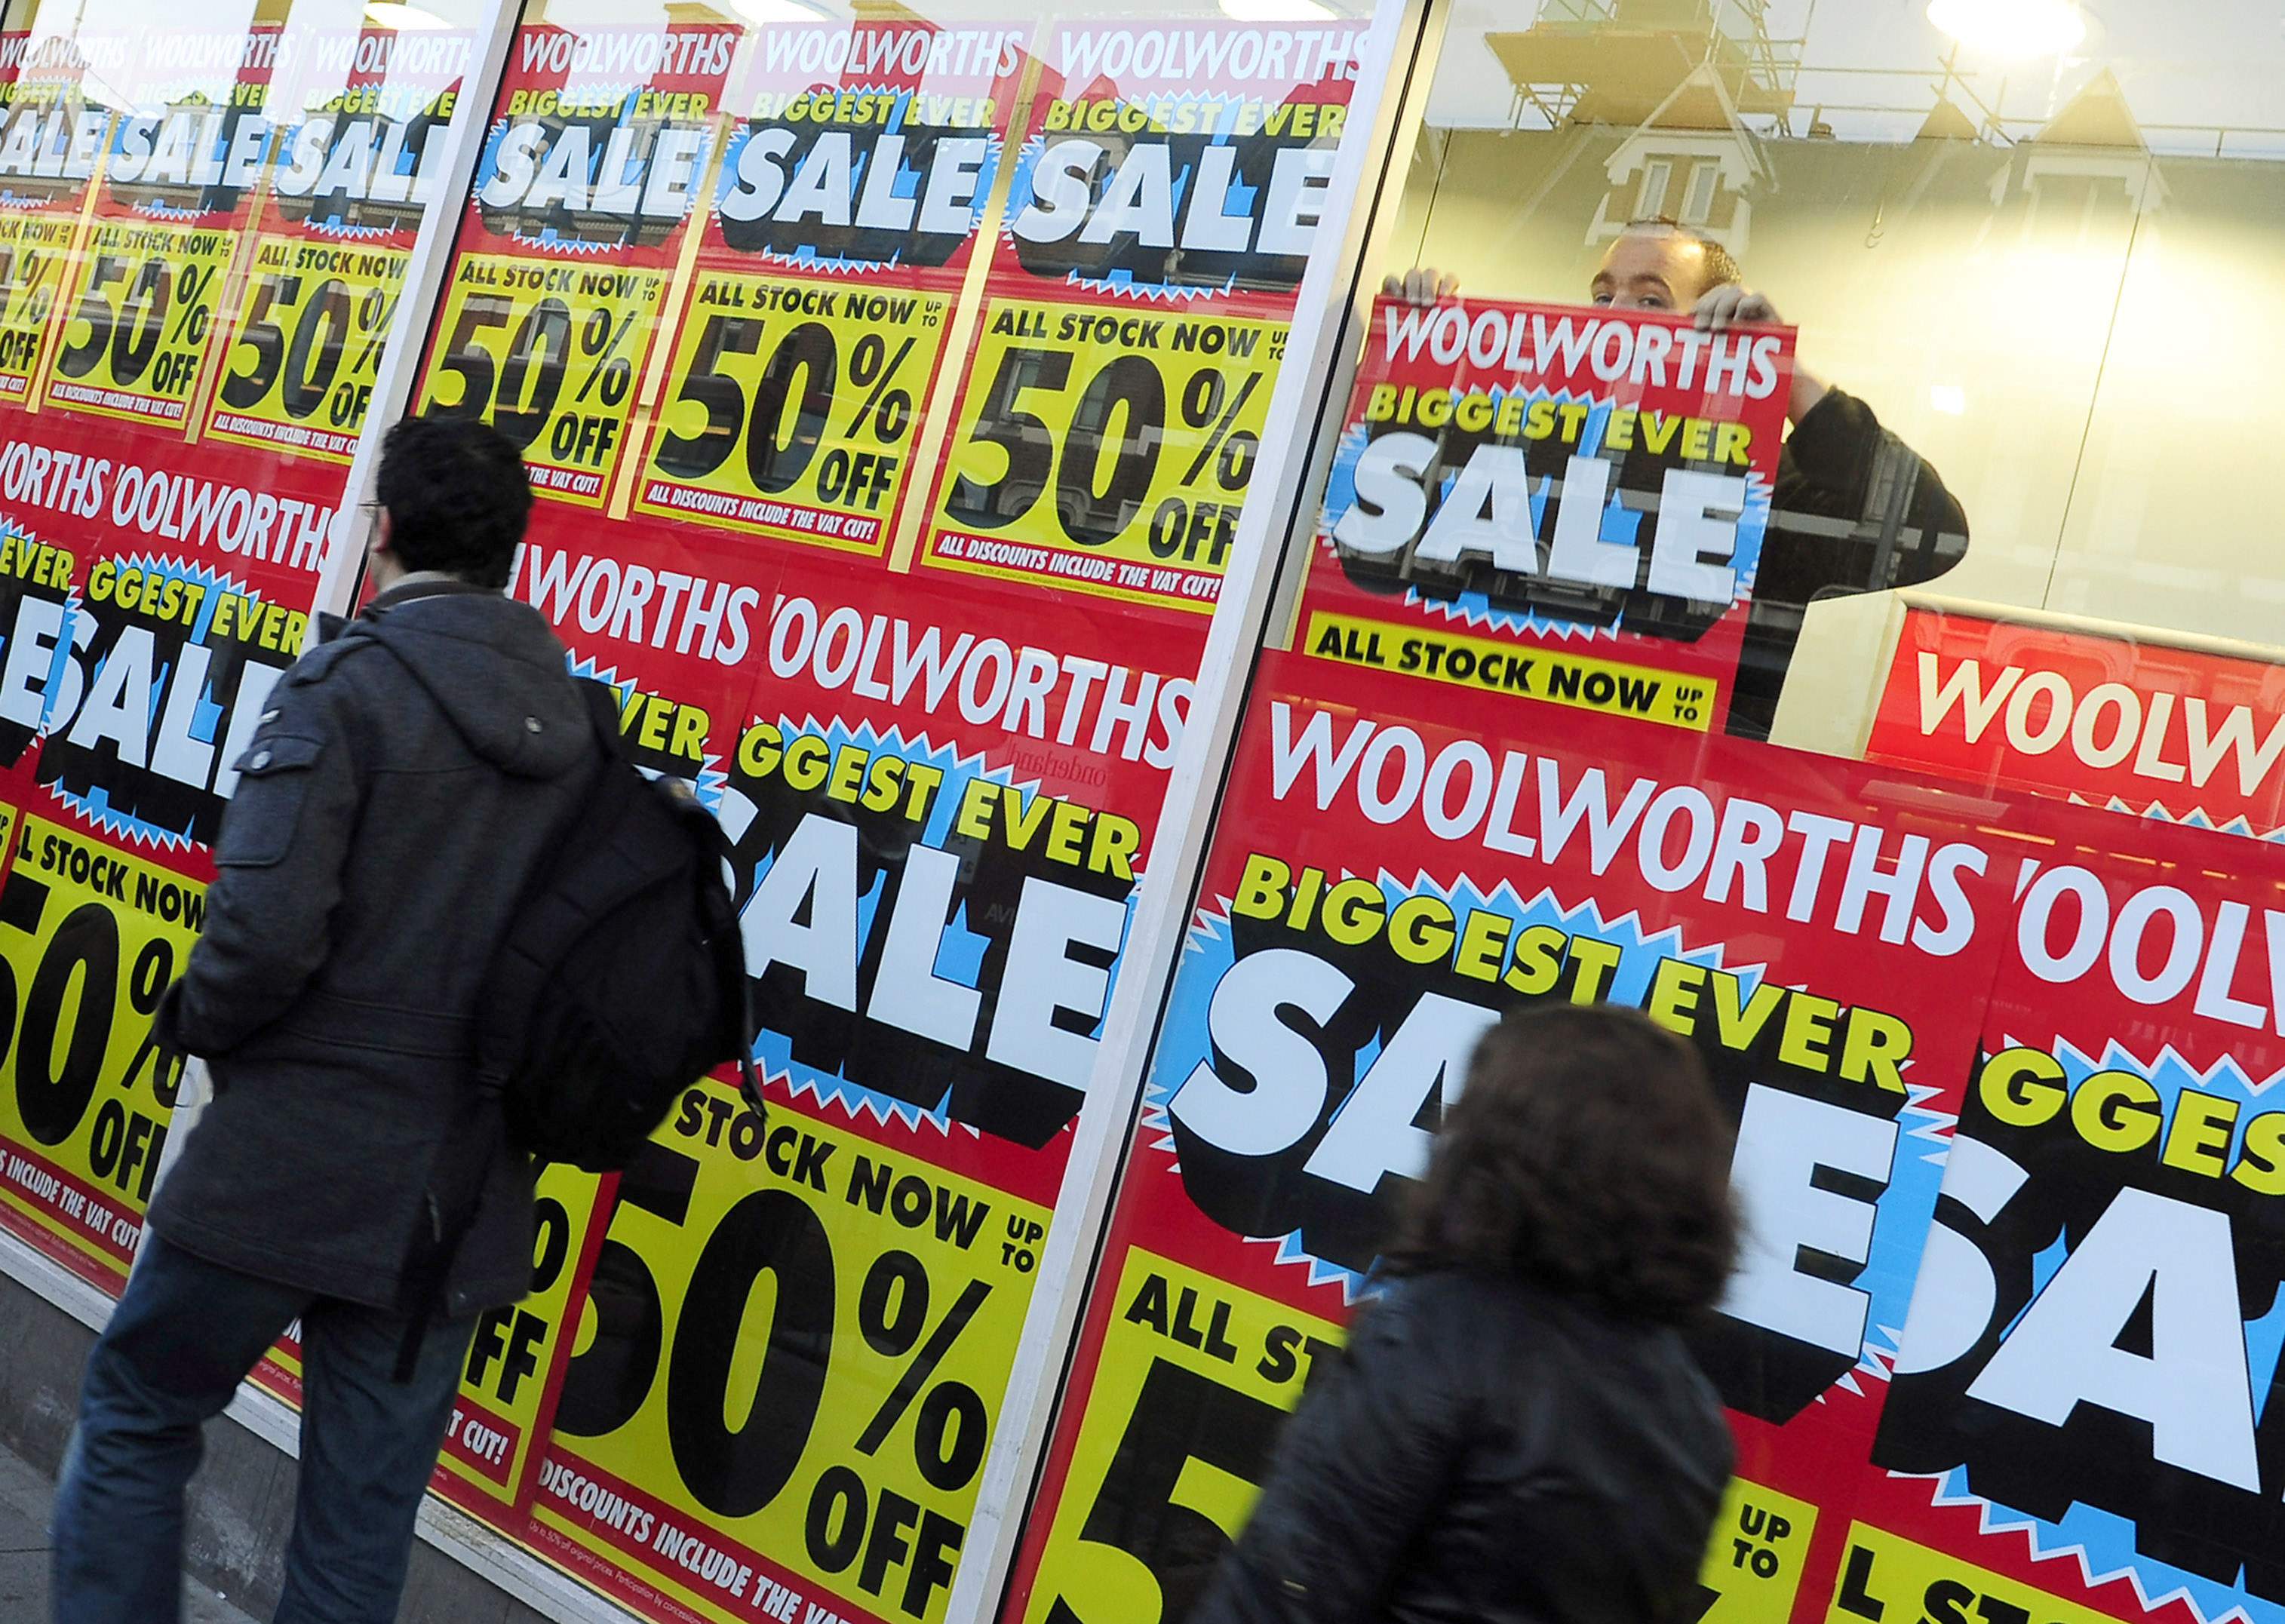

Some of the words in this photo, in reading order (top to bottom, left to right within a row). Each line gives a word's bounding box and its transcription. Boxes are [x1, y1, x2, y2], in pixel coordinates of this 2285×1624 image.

[145, 32, 295, 69] WOOLWORTHS
[522, 32, 735, 75] WOOLWORTHS
[766, 29, 1023, 78] WOOLWORTHS
[1061, 29, 1371, 83] WOOLWORTHS
[508, 90, 628, 118] BIGGEST
[634, 92, 709, 121] EVER
[751, 92, 895, 125] BIGGEST
[903, 95, 996, 128] EVER
[1045, 100, 1224, 135] BIGGEST
[1234, 103, 1347, 138] EVER
[110, 112, 266, 188] SALE
[479, 124, 702, 217] SALE
[720, 128, 988, 234] SALE
[1011, 140, 1340, 256] SALE
[93, 227, 120, 247] ALL
[124, 230, 176, 253] STOCK
[177, 235, 218, 256] NOW
[258, 245, 289, 267] ALL
[296, 247, 354, 274] STOCK
[358, 257, 408, 279] NOW
[460, 261, 497, 285] ALL
[503, 264, 574, 293] STOCK
[579, 273, 639, 299] NOW
[643, 290, 656, 301] TO
[645, 278, 659, 288] UP
[699, 280, 745, 307] ALL
[752, 284, 840, 318] STOCK
[844, 293, 917, 324] NOW
[925, 301, 942, 312] UP
[56, 256, 217, 387] 50%
[220, 275, 401, 419] 50%
[923, 315, 938, 327] TO
[990, 309, 1048, 338] ALL
[1057, 313, 1166, 349] STOCK
[1172, 323, 1264, 358] NOW
[1384, 303, 1782, 400] WOOLWORTHS
[152, 351, 198, 395] OFF
[424, 292, 638, 453] 50%
[654, 315, 917, 494] 50%
[551, 411, 619, 466] OFF
[944, 346, 1264, 546] 50%
[1365, 383, 1588, 444] BIGGEST
[1605, 409, 1753, 466] EVER
[529, 466, 551, 484] THE
[551, 470, 573, 489] VAT
[573, 474, 600, 494] CUT!
[647, 484, 670, 503] ALL
[671, 489, 740, 516] DISCOUNTS
[738, 500, 789, 526] INCLUDE
[790, 509, 816, 530] THE
[816, 514, 844, 534] VAT
[843, 518, 877, 540] CUT!
[817, 450, 898, 510] OFF
[1148, 497, 1242, 566] OFF
[1331, 431, 1747, 603] SALE
[0, 536, 75, 591] EVER
[938, 535, 964, 556] ALL
[966, 539, 1048, 571] DISCOUNTS
[1049, 552, 1115, 582] INCLUDE
[1116, 564, 1149, 588] THE
[1150, 570, 1182, 592] VAT
[1181, 575, 1222, 600] CUT!
[89, 561, 205, 626] GGEST
[212, 592, 309, 656] EVER
[505, 542, 760, 665] WORTHS
[768, 594, 1196, 769] OOLWORTHS
[1316, 626, 1386, 665] ALL
[1398, 640, 1536, 692] STOCK
[1546, 666, 1661, 713] NOW
[1675, 686, 1704, 702] UP
[1672, 705, 1698, 721] TO
[1916, 651, 2285, 797] WOOLW
[738, 723, 944, 823] GGEST
[956, 777, 1141, 882] EVER
[1270, 700, 1988, 956] WOOLWORTHS
[41, 834, 125, 903] STOCK
[135, 873, 204, 933] NOW
[1232, 854, 1621, 1005] BIGGEST
[1650, 956, 1913, 1094] EVER
[2012, 858, 2285, 1038] OOL
[674, 1089, 837, 1193] STOCK
[846, 1156, 990, 1251] NOW
[1167, 948, 1899, 1358] SAE
[6, 1155, 61, 1203] INCLUDE
[59, 1187, 87, 1219] THE
[84, 1201, 113, 1235] VAT
[1000, 1242, 1034, 1273] TO
[1006, 1214, 1043, 1245] UP
[552, 1139, 993, 1518] 50%
[1124, 1272, 1239, 1365] ALL
[465, 1304, 549, 1405] FF
[463, 1420, 509, 1466] CUT!
[539, 1457, 655, 1543] DISCOUNTS
[653, 1522, 753, 1598] INCLUDE
[751, 1574, 803, 1624] THE
[804, 1465, 965, 1619] OFF
[1739, 1503, 1792, 1544] UP
[570, 1546, 594, 1567] original
[615, 1570, 654, 1600] Participation
[1732, 1538, 1779, 1579] TO
